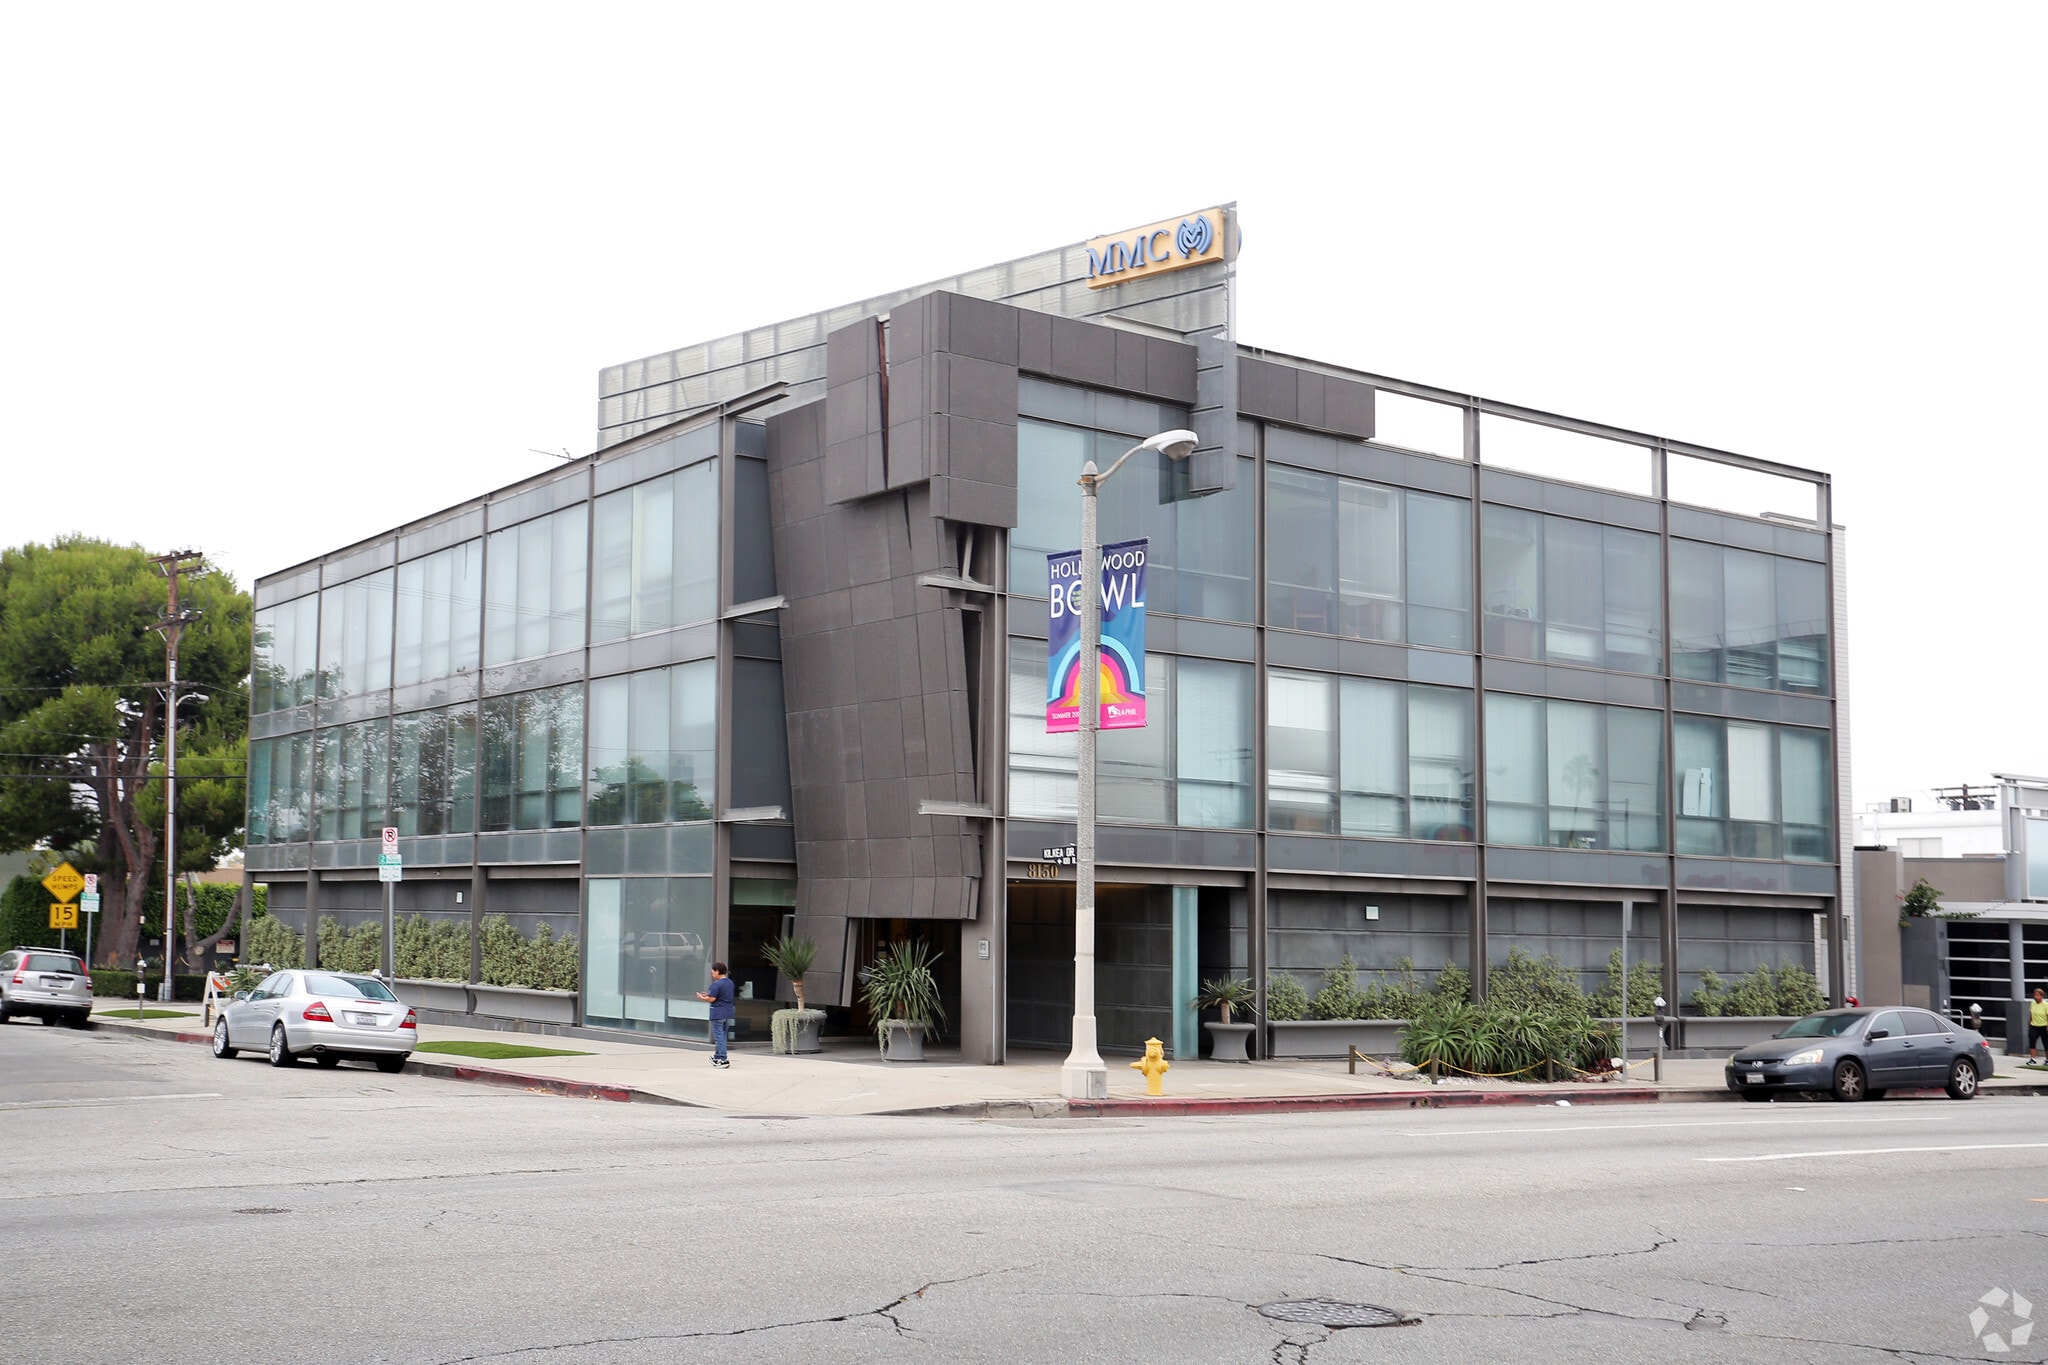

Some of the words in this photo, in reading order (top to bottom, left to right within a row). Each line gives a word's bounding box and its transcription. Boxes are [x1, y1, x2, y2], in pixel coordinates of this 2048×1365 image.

[1085, 229, 1170, 279] MMC
[1051, 550, 1145, 580] HOLLWOOD
[1028, 864, 1058, 878] 8150
[56, 907, 72, 920] 15
